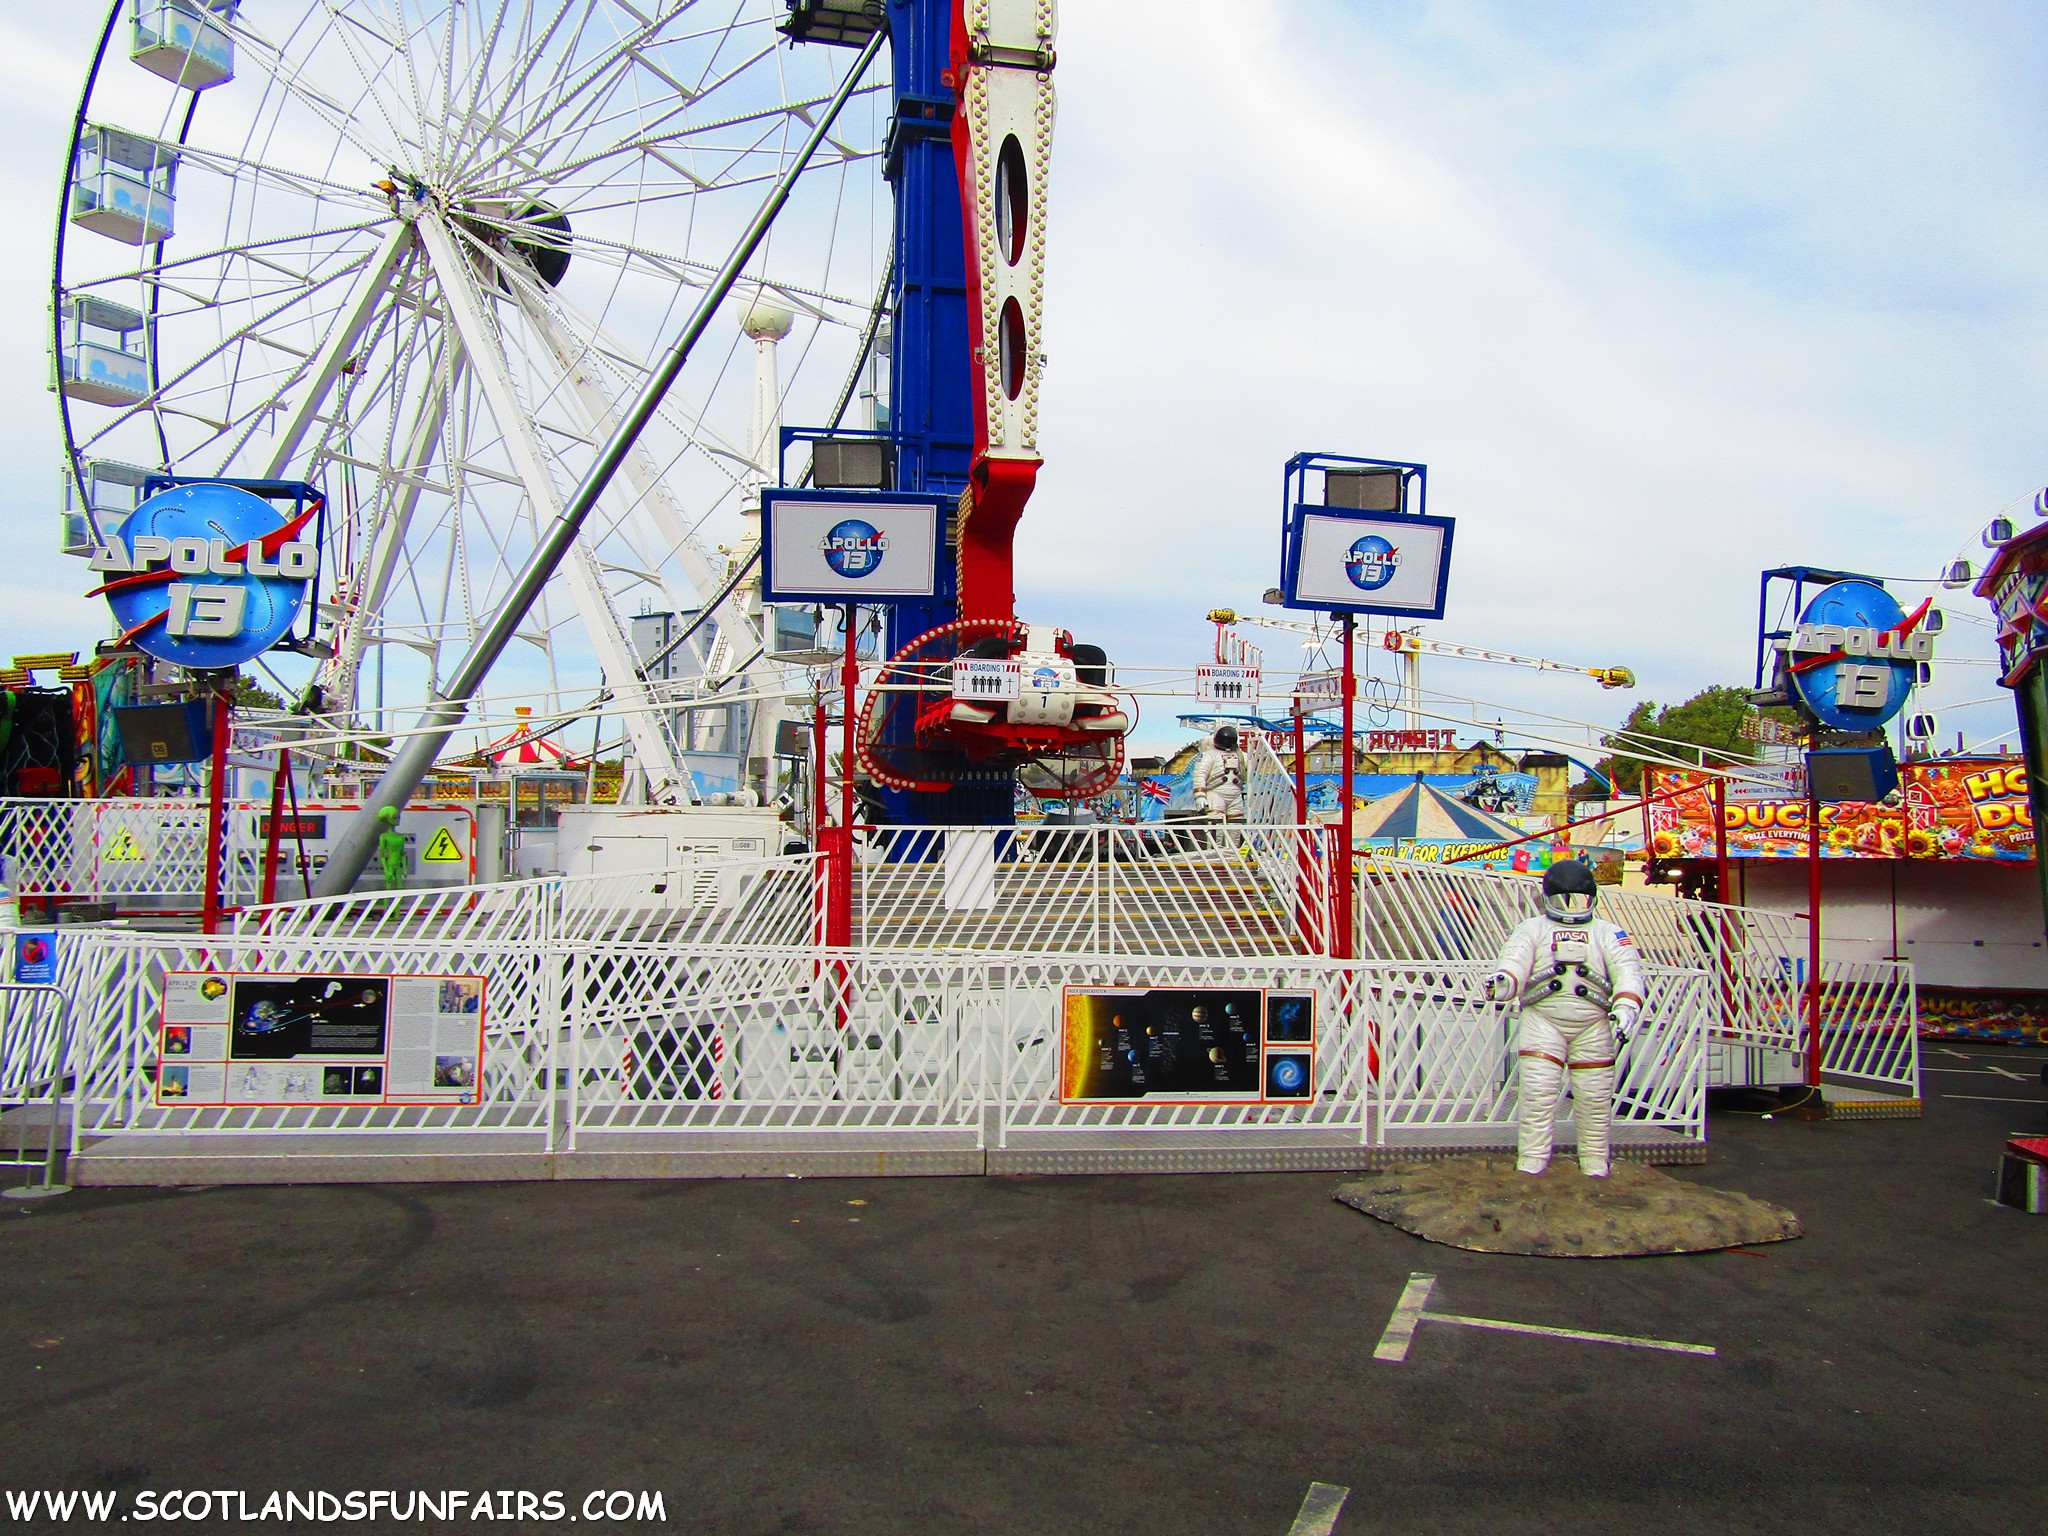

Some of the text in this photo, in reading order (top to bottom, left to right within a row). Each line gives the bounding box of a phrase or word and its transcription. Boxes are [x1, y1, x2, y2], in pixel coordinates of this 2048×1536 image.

[818, 536, 890, 551] APOLLO
[87, 535, 319, 578] APOLLO
[842, 551, 866, 569] 13
[1340, 549, 1402, 567] APOLLO
[1360, 564, 1382, 582] 13
[165, 583, 248, 638] 13
[1787, 623, 1934, 660] APOLLO
[970, 663, 1001, 672] BOARDING
[1211, 669, 1245, 678] BOARDING 2
[1835, 664, 1891, 708] 13
[1041, 696, 1047, 708] 1
[1725, 804, 1839, 827] DUCK
[262, 822, 316, 832] DNGER
[1743, 831, 1767, 842] PRIZE
[1411, 844, 1439, 862] FOR
[1441, 841, 1511, 862] EVERYONE
[1555, 931, 1588, 942] NASA
[1914, 1020, 1941, 1034] INNER
